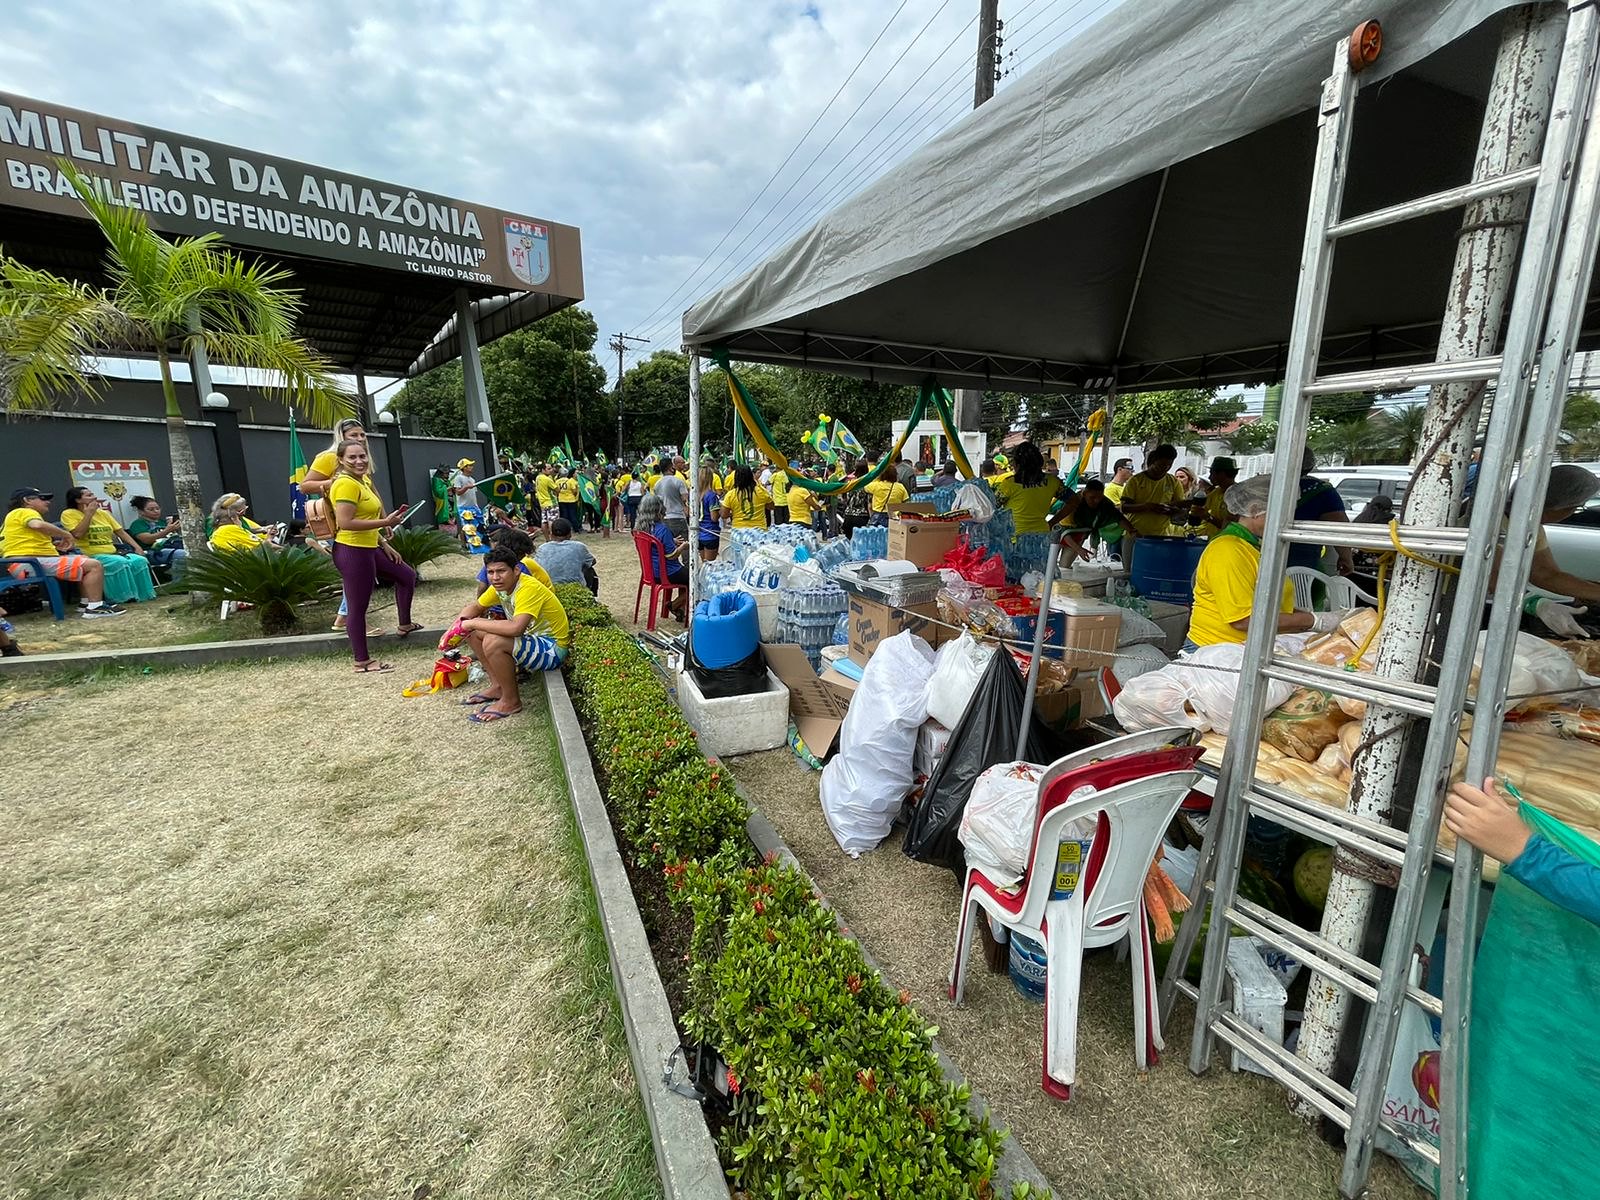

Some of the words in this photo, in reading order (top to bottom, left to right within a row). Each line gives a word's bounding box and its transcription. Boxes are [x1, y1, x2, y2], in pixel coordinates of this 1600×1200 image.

[0, 104, 216, 186] MILITAR
[228, 157, 289, 200] DA
[299, 174, 484, 241] AMAZÔNIA
[6, 158, 188, 216] BRASILEIRO
[192, 194, 351, 245] DEFENDENDO
[357, 226, 373, 250] A
[405, 261, 420, 272] TC
[421, 263, 454, 278] LAURO
[457, 269, 493, 283] PASTOR
